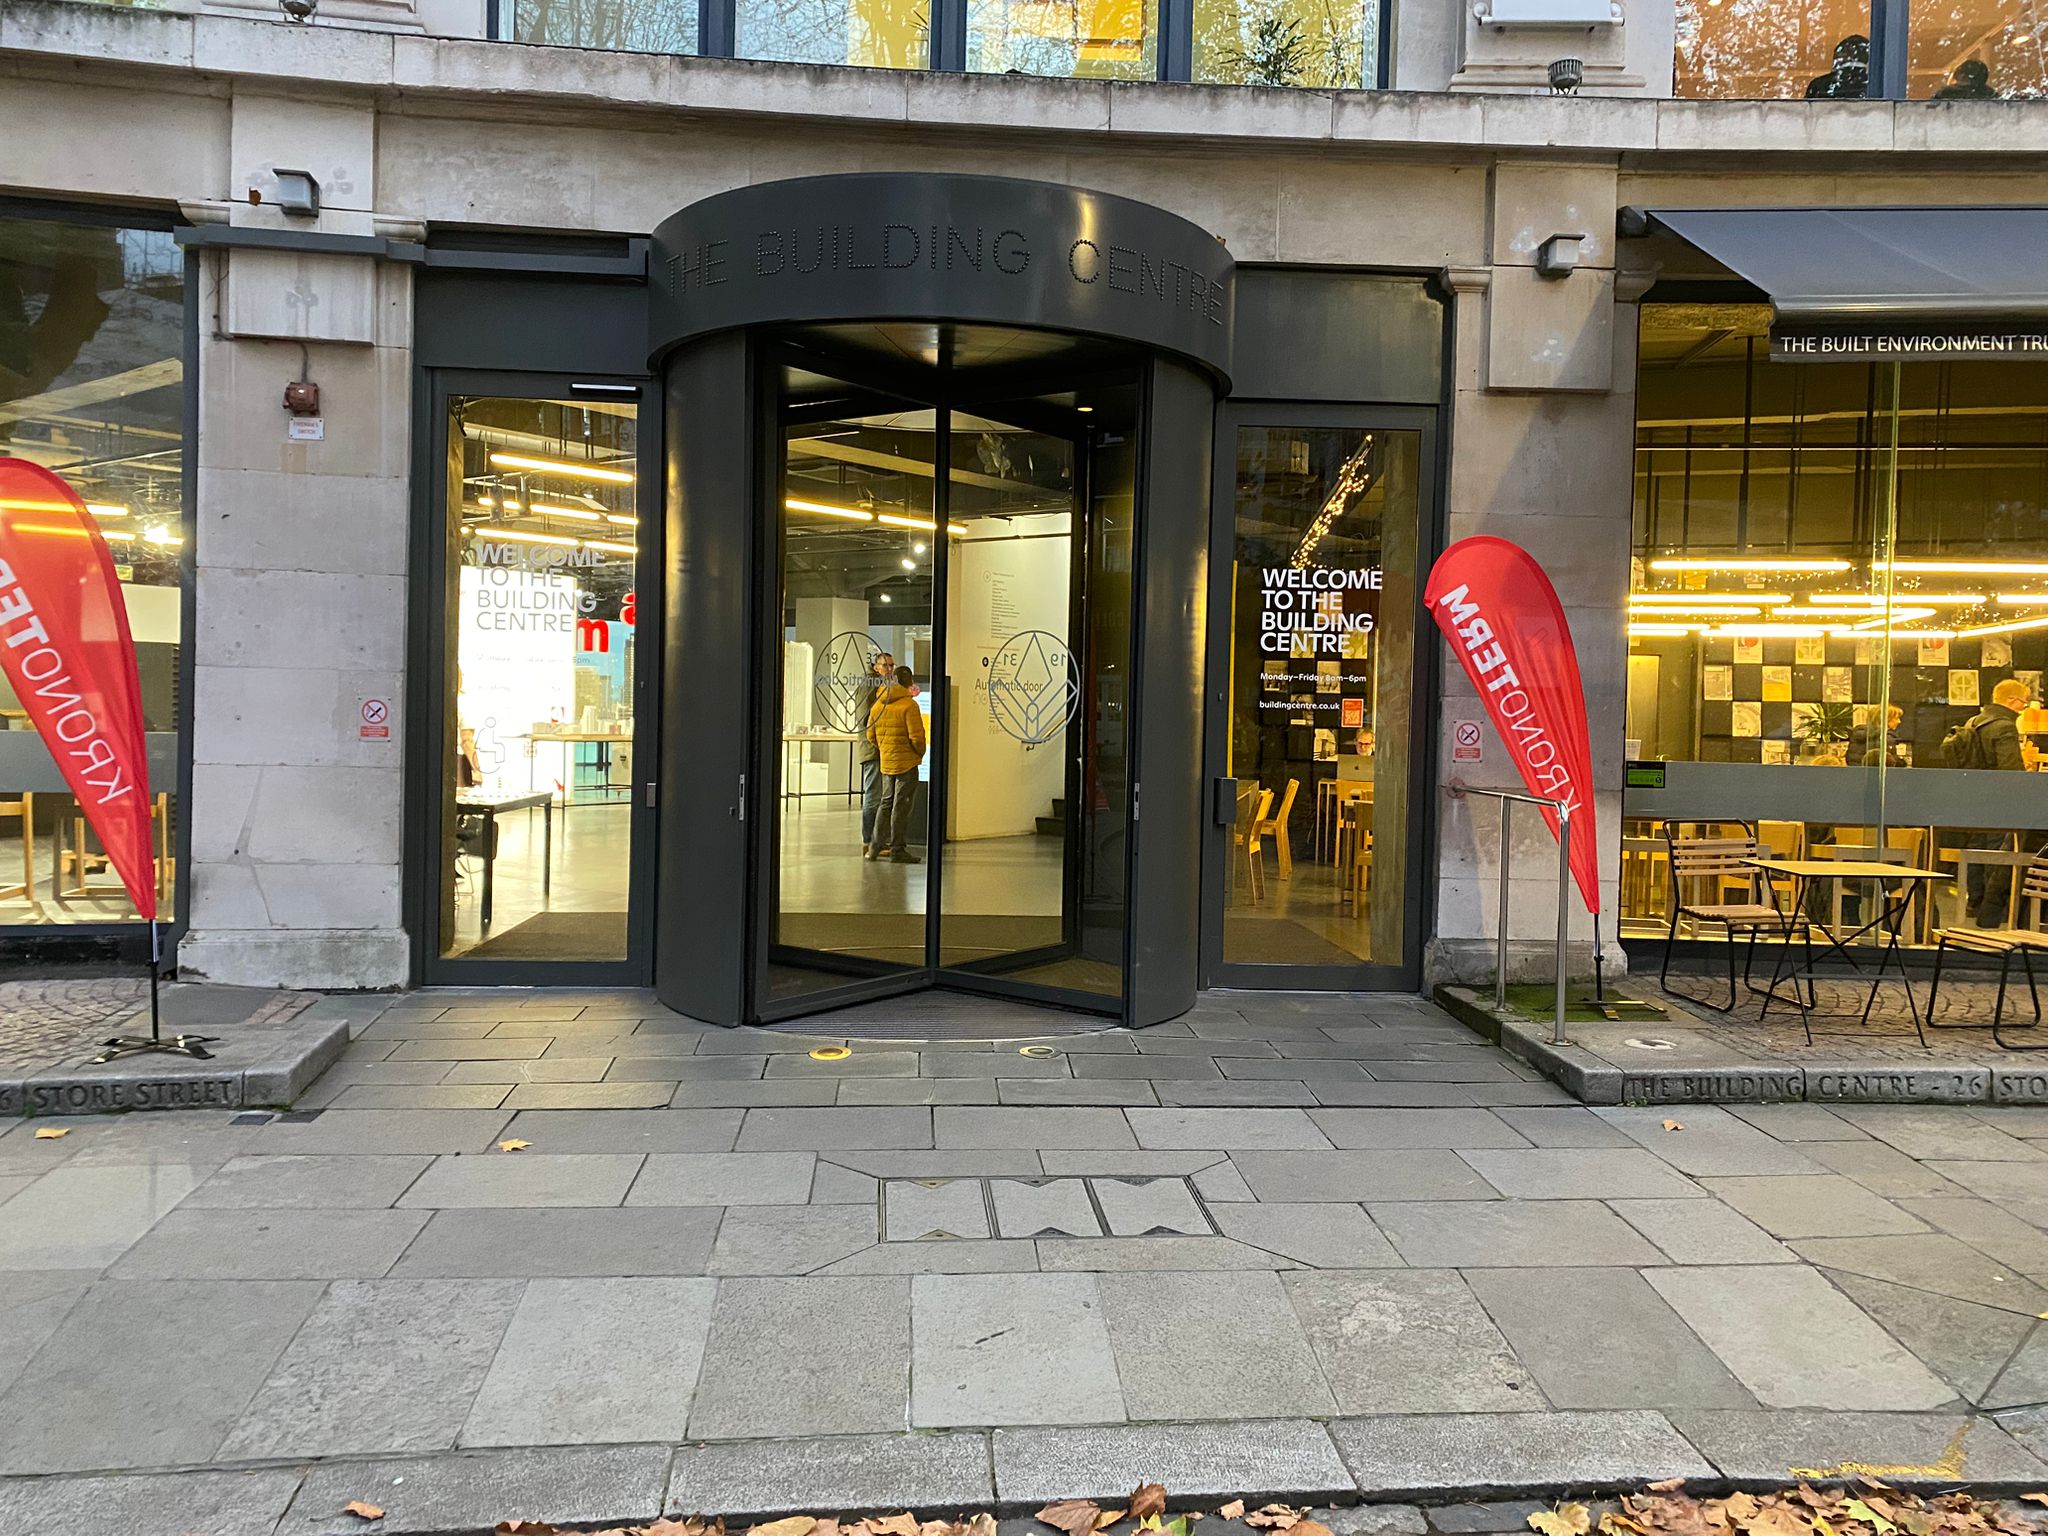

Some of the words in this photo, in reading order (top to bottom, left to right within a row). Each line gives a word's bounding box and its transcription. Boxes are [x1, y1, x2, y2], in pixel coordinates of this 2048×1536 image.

[665, 239, 728, 297] THE
[757, 224, 1031, 276] BUILDING
[1068, 238, 1224, 326] CENTRE
[1781, 336, 1817, 353] THE
[1821, 335, 1874, 352] BUILT
[1877, 334, 2017, 352] ENVIRONMENT
[476, 543, 607, 567] WELCOME
[476, 566, 509, 587] TO
[518, 567, 563, 588] THE
[1262, 568, 1384, 590] WELCOME
[477, 589, 597, 613] BUILDING
[1260, 589, 1294, 610] TO
[1297, 590, 1343, 611] THE
[476, 611, 572, 632] CENTRE
[1261, 611, 1374, 633] BUILDING
[1259, 632, 1351, 653] CENTRE
[1259, 701, 1340, 711] buildingcentre.co.uk
[32, 1083, 124, 1109] STORE
[135, 1079, 233, 1105] STREET
[1626, 1076, 1671, 1097] THE
[1682, 1076, 1801, 1098] BUILDING
[1818, 1075, 1917, 1096] CENTRE
[1952, 1075, 1982, 1096] 26
